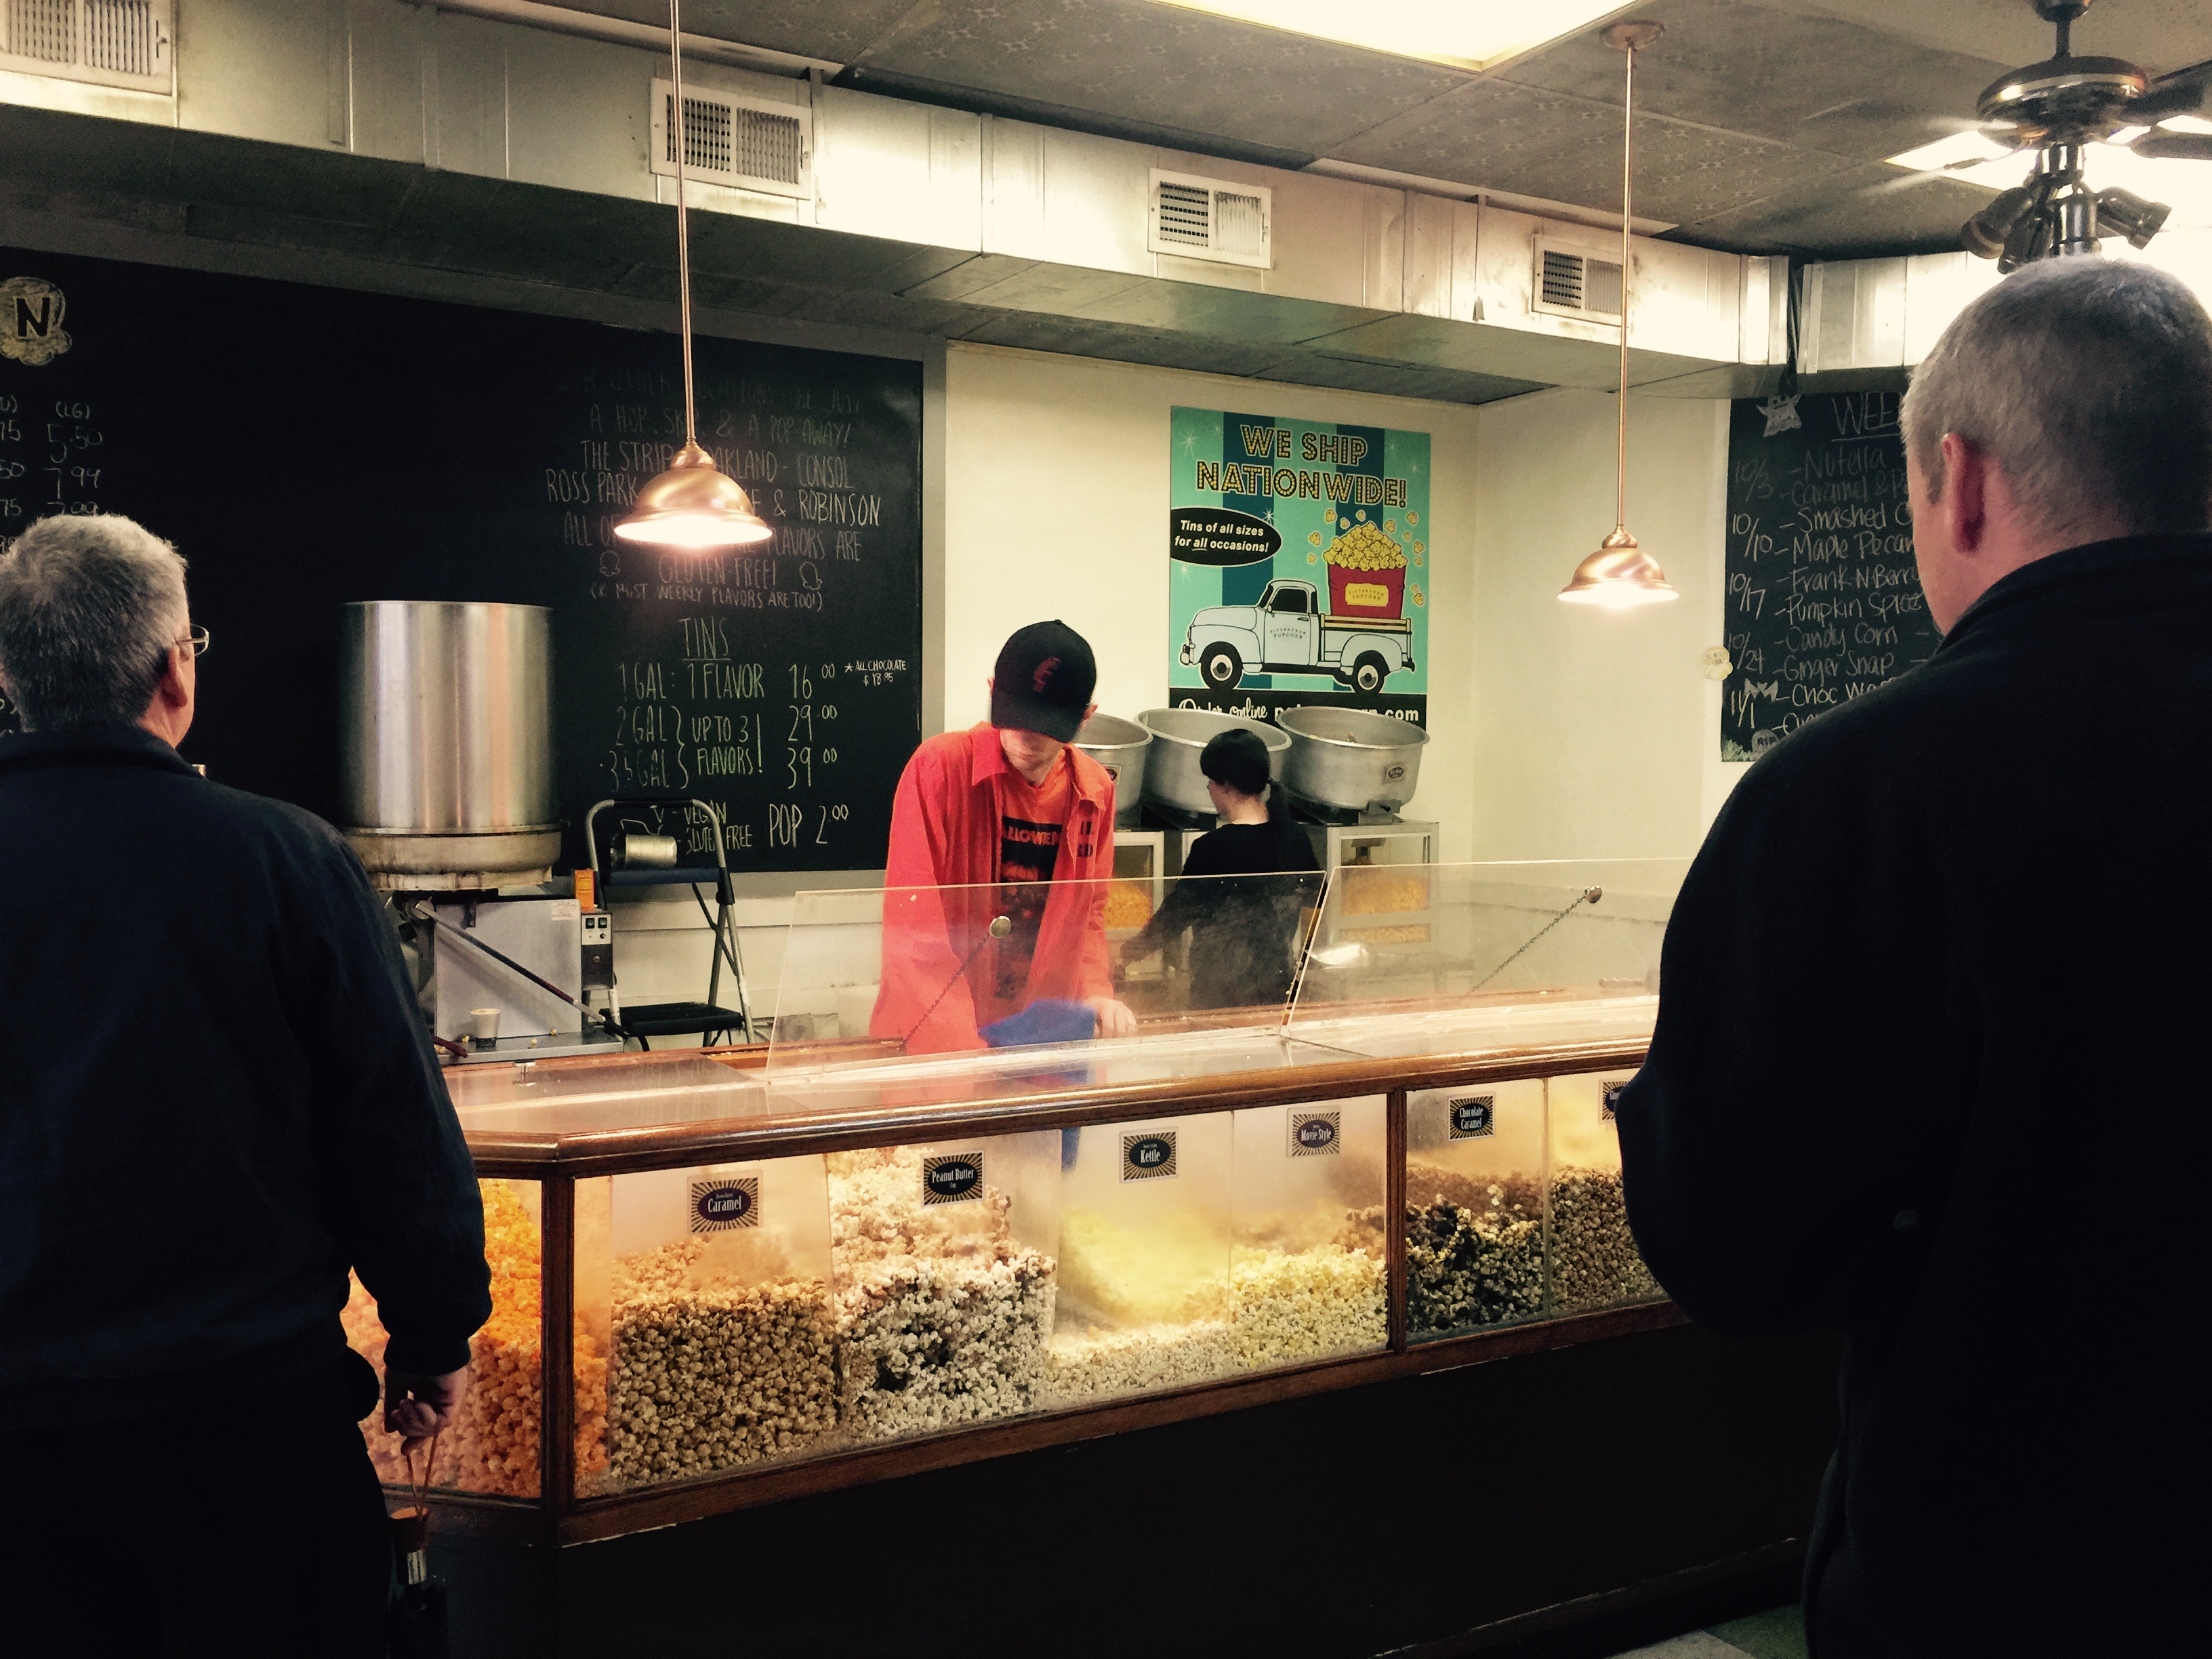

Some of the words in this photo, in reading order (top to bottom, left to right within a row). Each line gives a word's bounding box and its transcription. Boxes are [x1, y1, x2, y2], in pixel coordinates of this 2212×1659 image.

[16, 297, 51, 337] N
[1241, 425, 1292, 459] WE
[1301, 432, 1368, 467] SHIP
[580, 439, 610, 471] THE
[619, 441, 674, 472] STRIP
[797, 453, 854, 489] CONSOL
[546, 468, 590, 504] ROSS
[598, 471, 638, 506] PARK
[774, 489, 786, 516] &
[798, 489, 881, 527] ROBINSON
[1197, 460, 1407, 508] NATIONWIDE!
[1180, 520, 1203, 532] Tins
[1206, 523, 1218, 533] of
[1220, 523, 1233, 534] all
[1235, 525, 1264, 537] sizes
[1797, 501, 1887, 533] Smashed
[565, 511, 593, 546] ALL
[836, 530, 863, 562] ARE
[1174, 535, 1191, 547] for
[1193, 537, 1208, 550] all
[1210, 540, 1269, 552] occasions!
[1793, 532, 1849, 565] Maple
[657, 584, 703, 603] WEEKLY
[712, 588, 764, 609] FLAVORS
[768, 591, 790, 609] ARE
[1786, 593, 1862, 628] Pumpkin
[678, 617, 729, 658] TINS
[1786, 623, 1846, 657] Candy
[1854, 621, 1898, 647] Corn
[703, 663, 765, 699] FLAVOR
[1845, 650, 1895, 677] Snap
[1792, 683, 1839, 707] Choc
[633, 705, 668, 744] GAL
[691, 716, 712, 743] UP
[714, 716, 731, 743] TO
[637, 749, 670, 788] GAL
[686, 825, 715, 855] GLUTE
[726, 825, 753, 851] FREE
[769, 803, 802, 848] POP
[1141, 1148, 1161, 1164] Kettle
[932, 1170, 954, 1183] Peanut
[955, 1168, 975, 1181] Butter
[708, 1195, 742, 1213] Caramel
